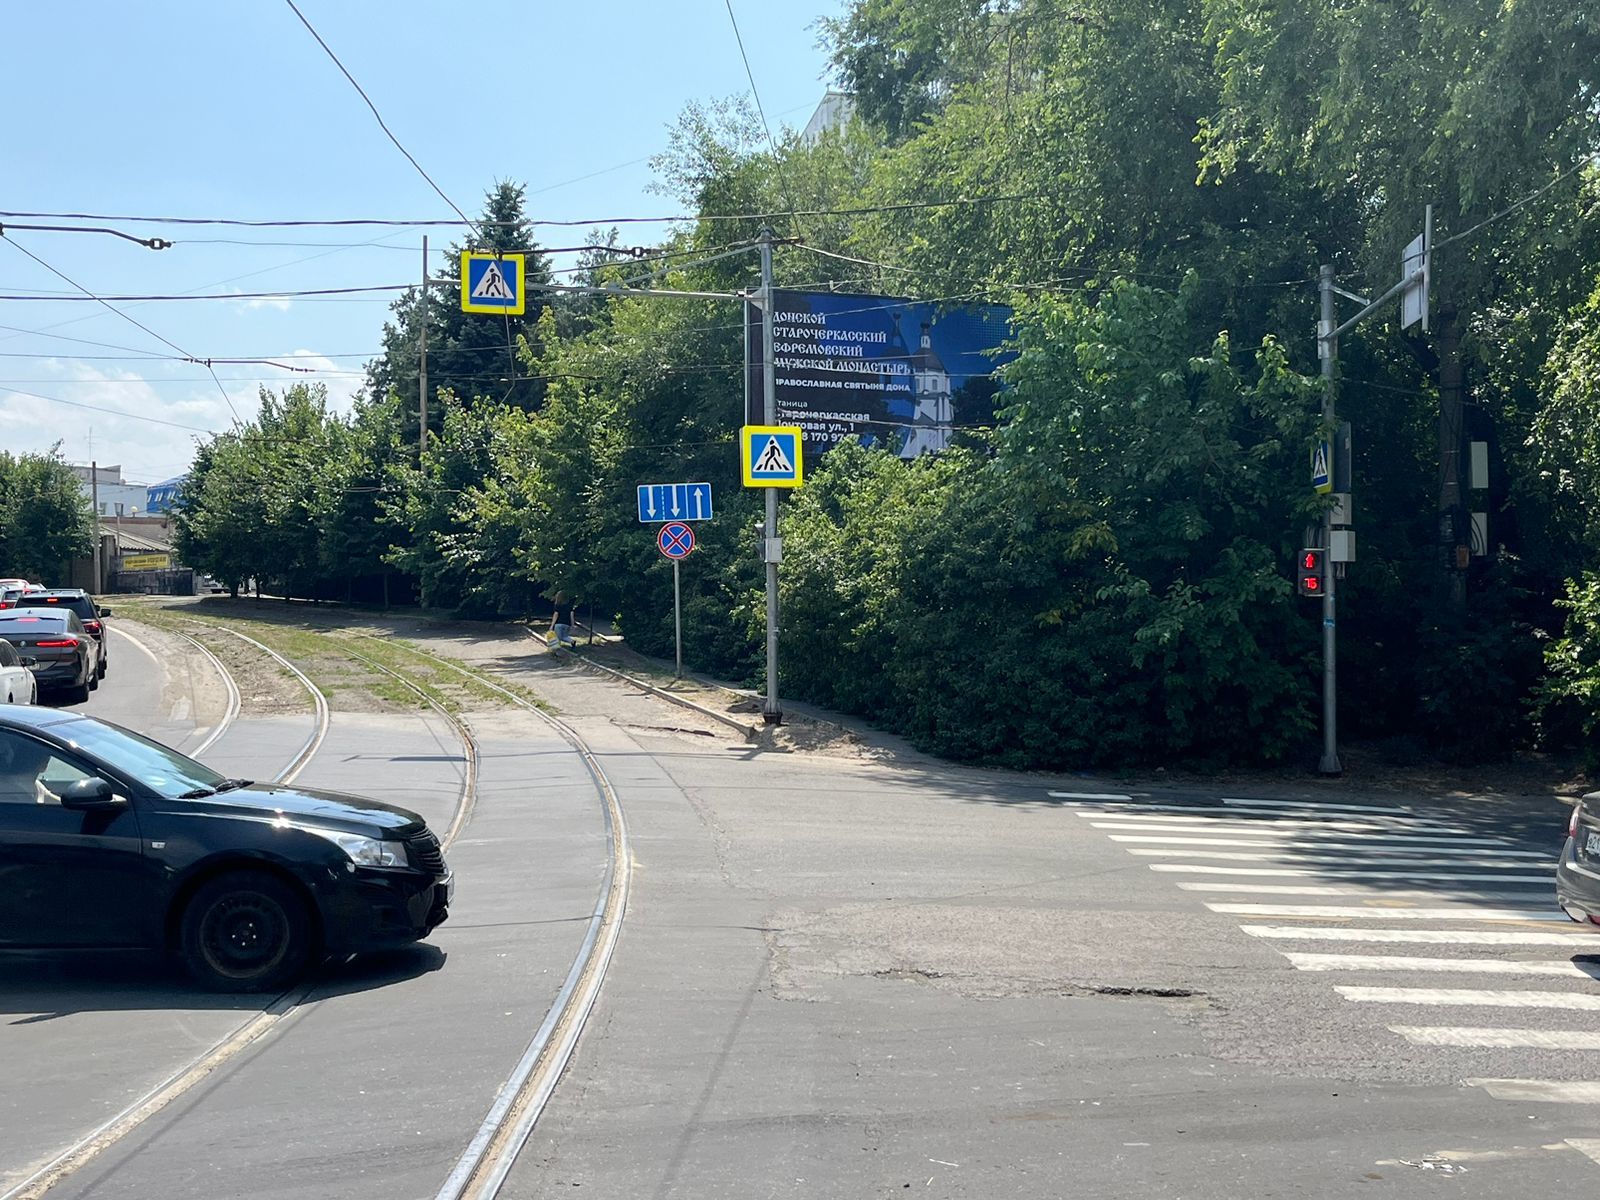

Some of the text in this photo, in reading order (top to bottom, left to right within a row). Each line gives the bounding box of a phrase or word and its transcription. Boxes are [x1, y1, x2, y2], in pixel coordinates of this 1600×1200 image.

[773, 311, 826, 324] ДОНСКОЙ
[773, 327, 887, 343] СТАРОЧЕРКАССКИЙ
[773, 342, 863, 357] ЕФРЕМОВСКИЙ
[837, 361, 911, 375] МОНАСТЫРЬ
[844, 381, 885, 391] СВЯТЫНЯ
[886, 384, 911, 392] ДОНА
[777, 399, 808, 408] таница
[776, 408, 870, 421] тарочеркасская
[828, 422, 847, 432] ул.,
[850, 423, 855, 431] 1
[810, 432, 829, 441] 170
